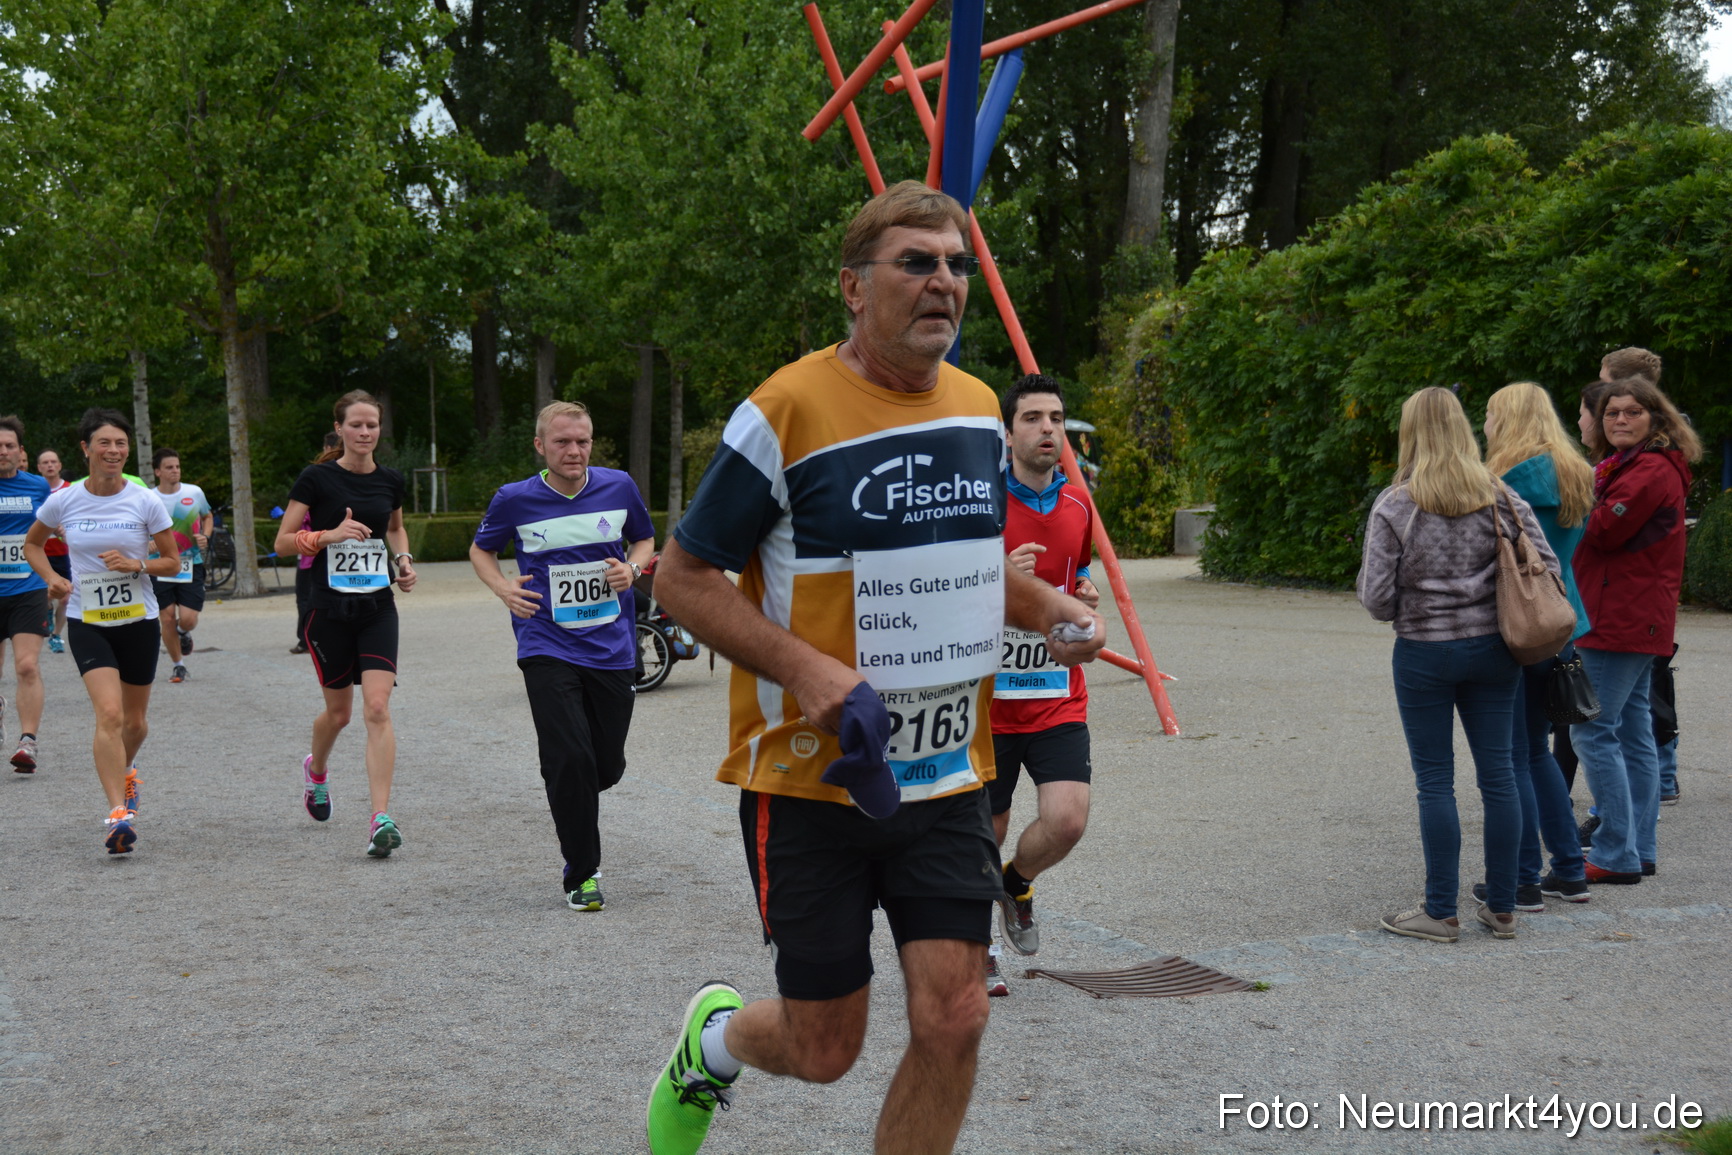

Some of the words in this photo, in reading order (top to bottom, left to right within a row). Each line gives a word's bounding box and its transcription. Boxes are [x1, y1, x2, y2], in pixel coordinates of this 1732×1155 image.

[887, 473, 992, 510] Fischer
[902, 503, 994, 525] AUTOMOBILE
[335, 552, 383, 572] 2217
[102, 574, 131, 583] Neumarkt
[348, 576, 372, 586] Maria
[551, 570, 576, 578] PARTL
[857, 579, 904, 598] Alles
[909, 577, 950, 595] Gute
[954, 569, 979, 590] und
[981, 564, 1000, 585] viel
[93, 582, 133, 607] 125
[558, 577, 612, 604] 2064
[99, 609, 131, 621] Brigitte
[577, 608, 600, 619] Peter
[858, 611, 918, 631] Glück,
[860, 651, 905, 668] Lena
[911, 644, 943, 665] und
[947, 637, 994, 660] Thomas
[917, 681, 967, 703] Neumarkt
[1008, 676, 1046, 688] Florian
[889, 694, 971, 755] 2163
[796, 737, 814, 751] FIAT
[903, 763, 937, 782] Otto
